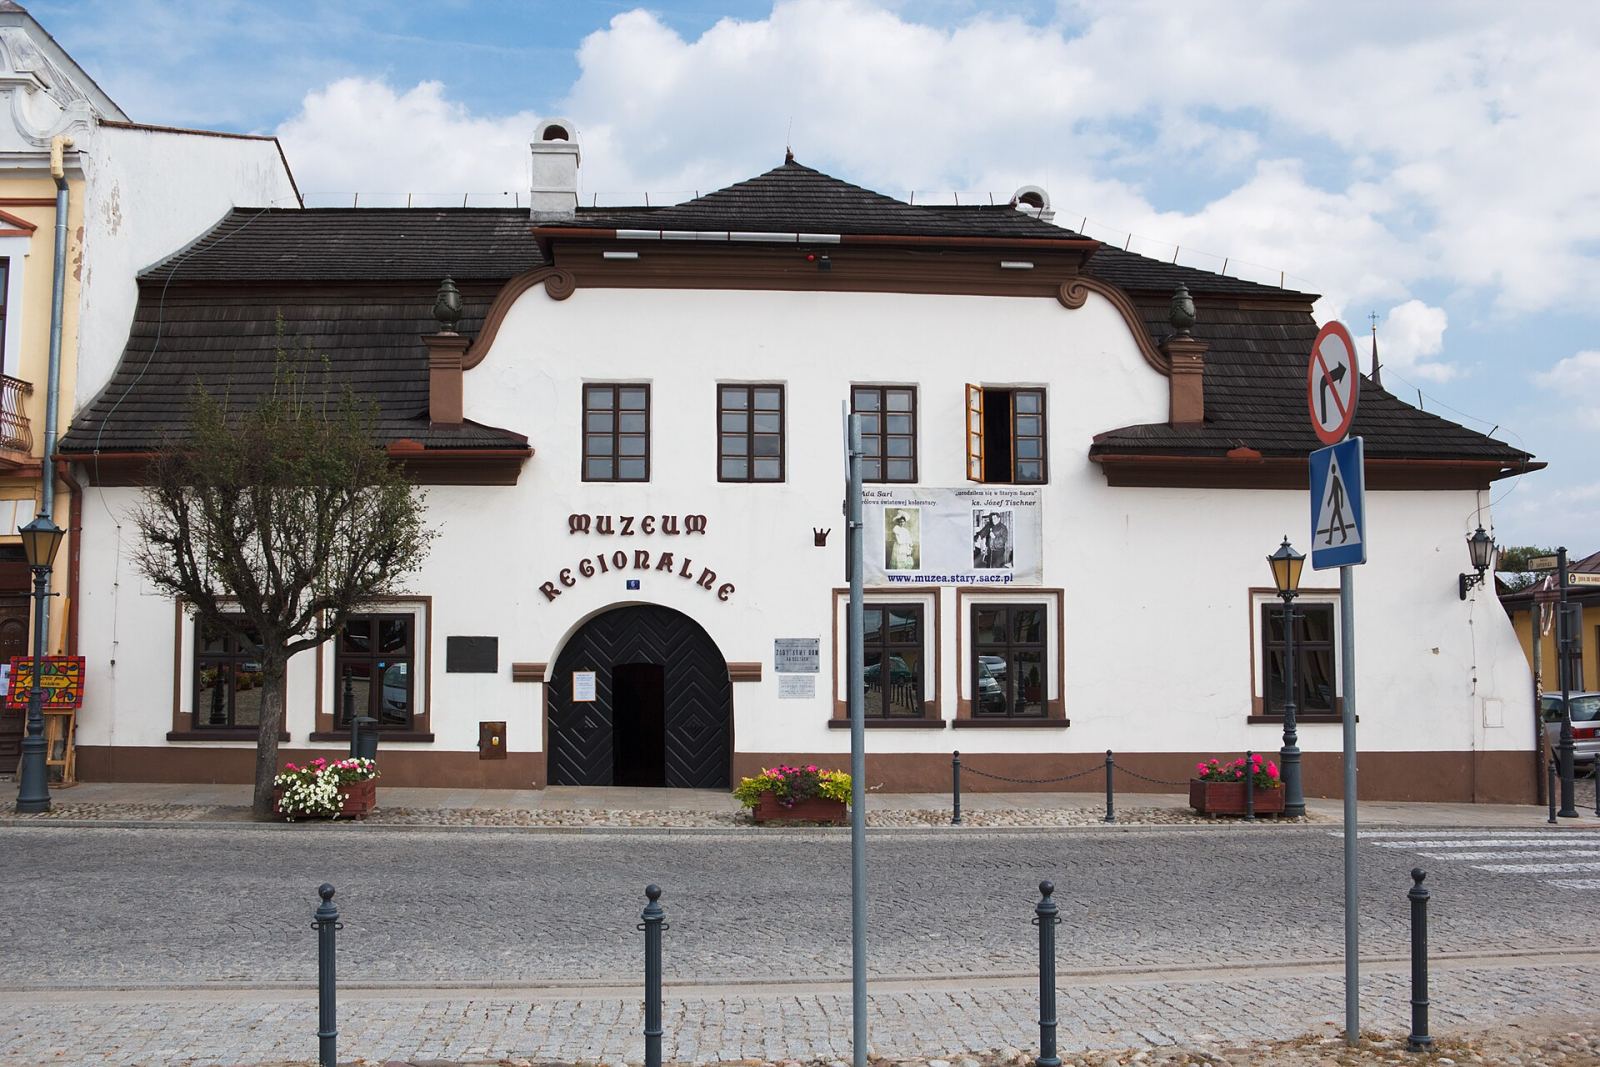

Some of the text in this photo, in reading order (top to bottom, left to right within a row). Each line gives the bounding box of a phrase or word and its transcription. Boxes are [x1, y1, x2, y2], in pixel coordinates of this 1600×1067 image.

[568, 513, 707, 536] MUZEUM
[538, 550, 736, 602] REGIONALNE
[887, 573, 1013, 584] www.muzea.stary.sacz.pl
